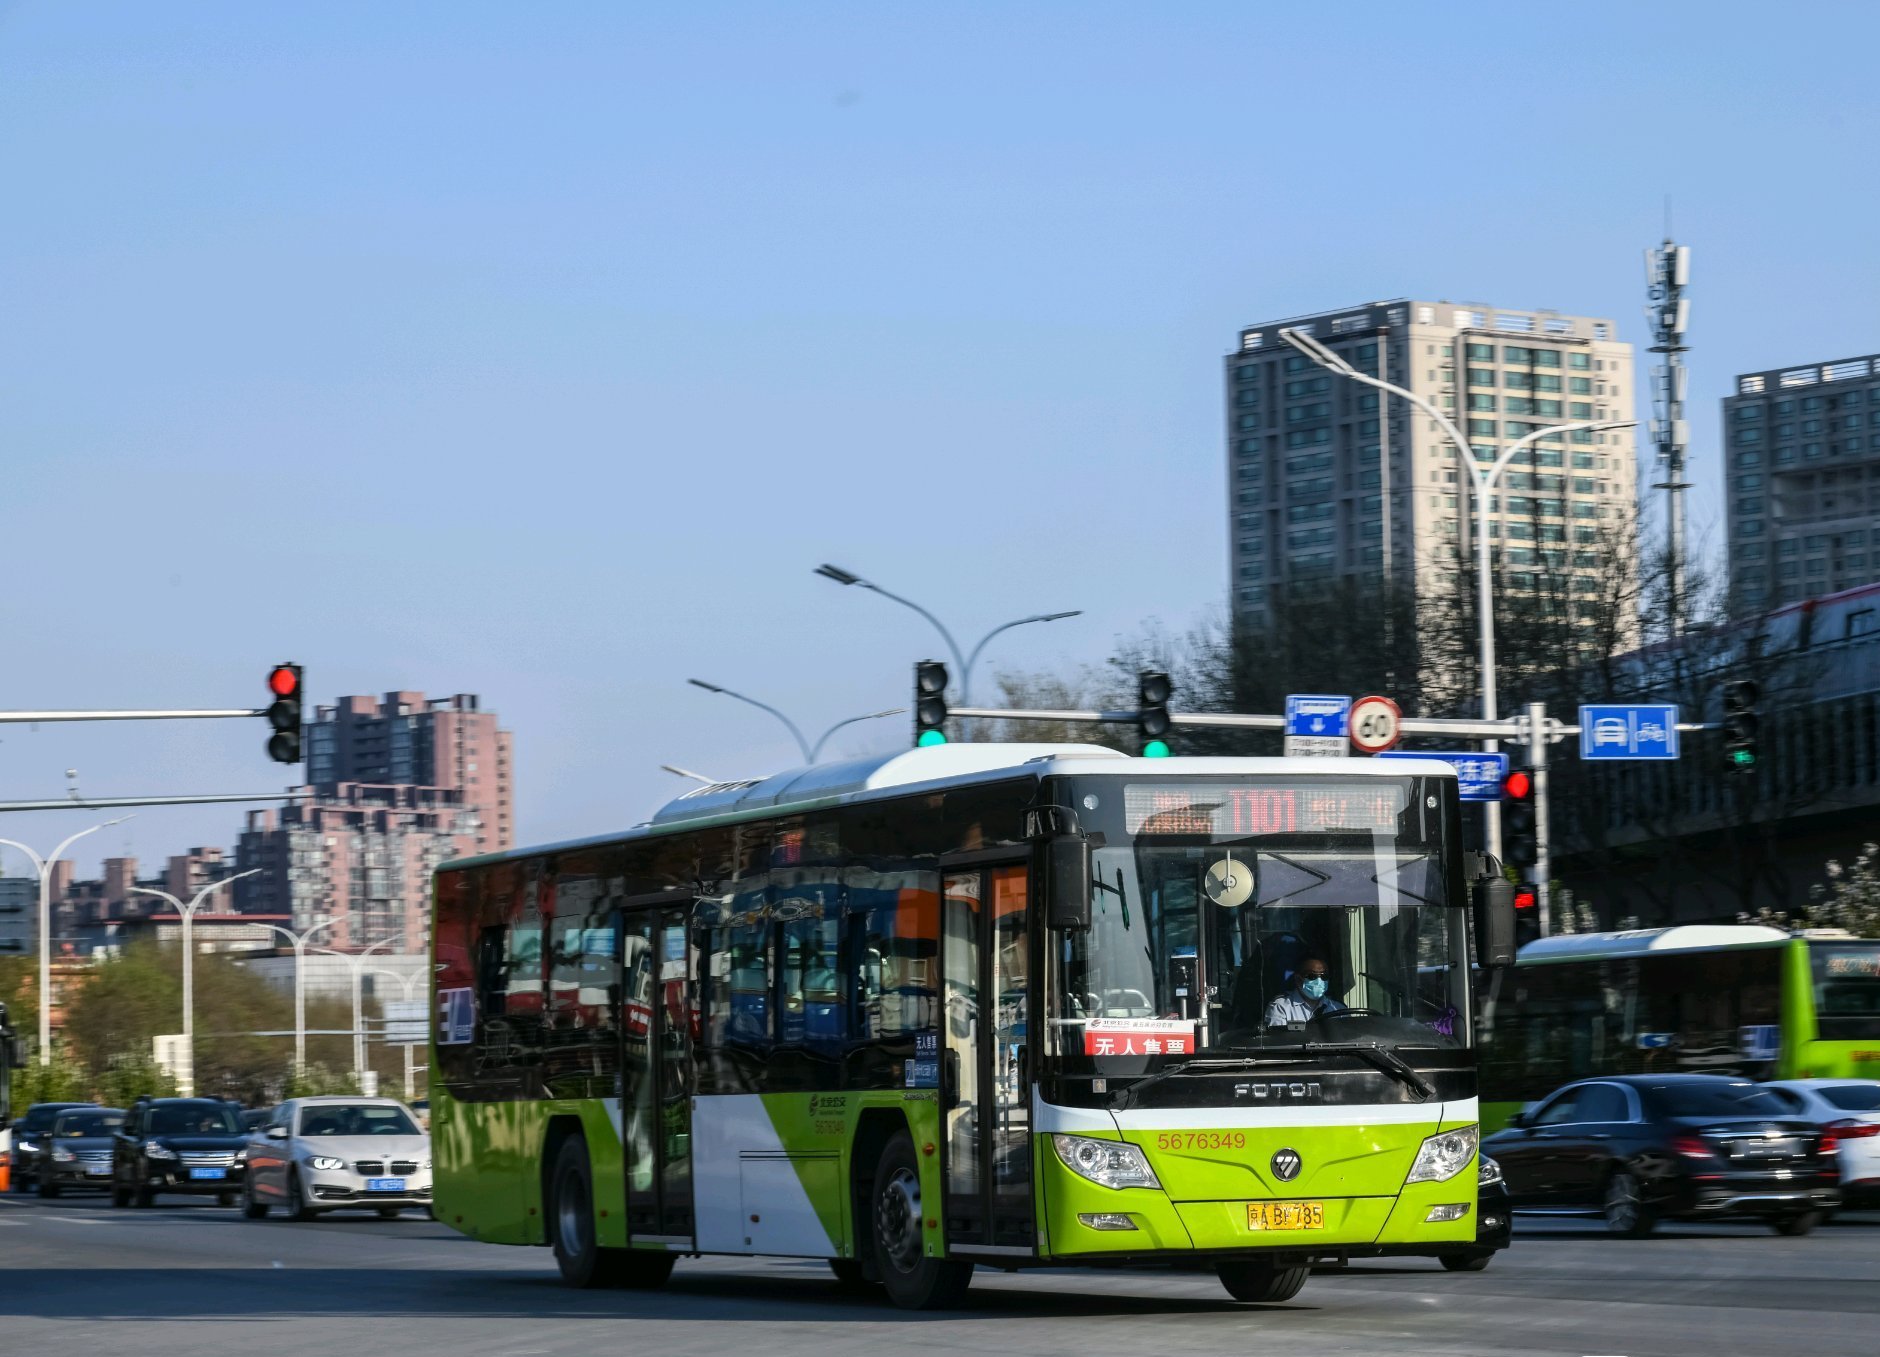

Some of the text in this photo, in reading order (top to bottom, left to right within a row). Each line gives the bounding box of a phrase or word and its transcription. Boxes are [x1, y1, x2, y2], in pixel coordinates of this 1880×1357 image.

[1360, 714, 1391, 738] 60
[1228, 789, 1295, 832] T101
[1095, 1038, 1186, 1055] 无人售票
[1234, 1083, 1321, 1098] FOTON
[1157, 1132, 1246, 1150] 5676349
